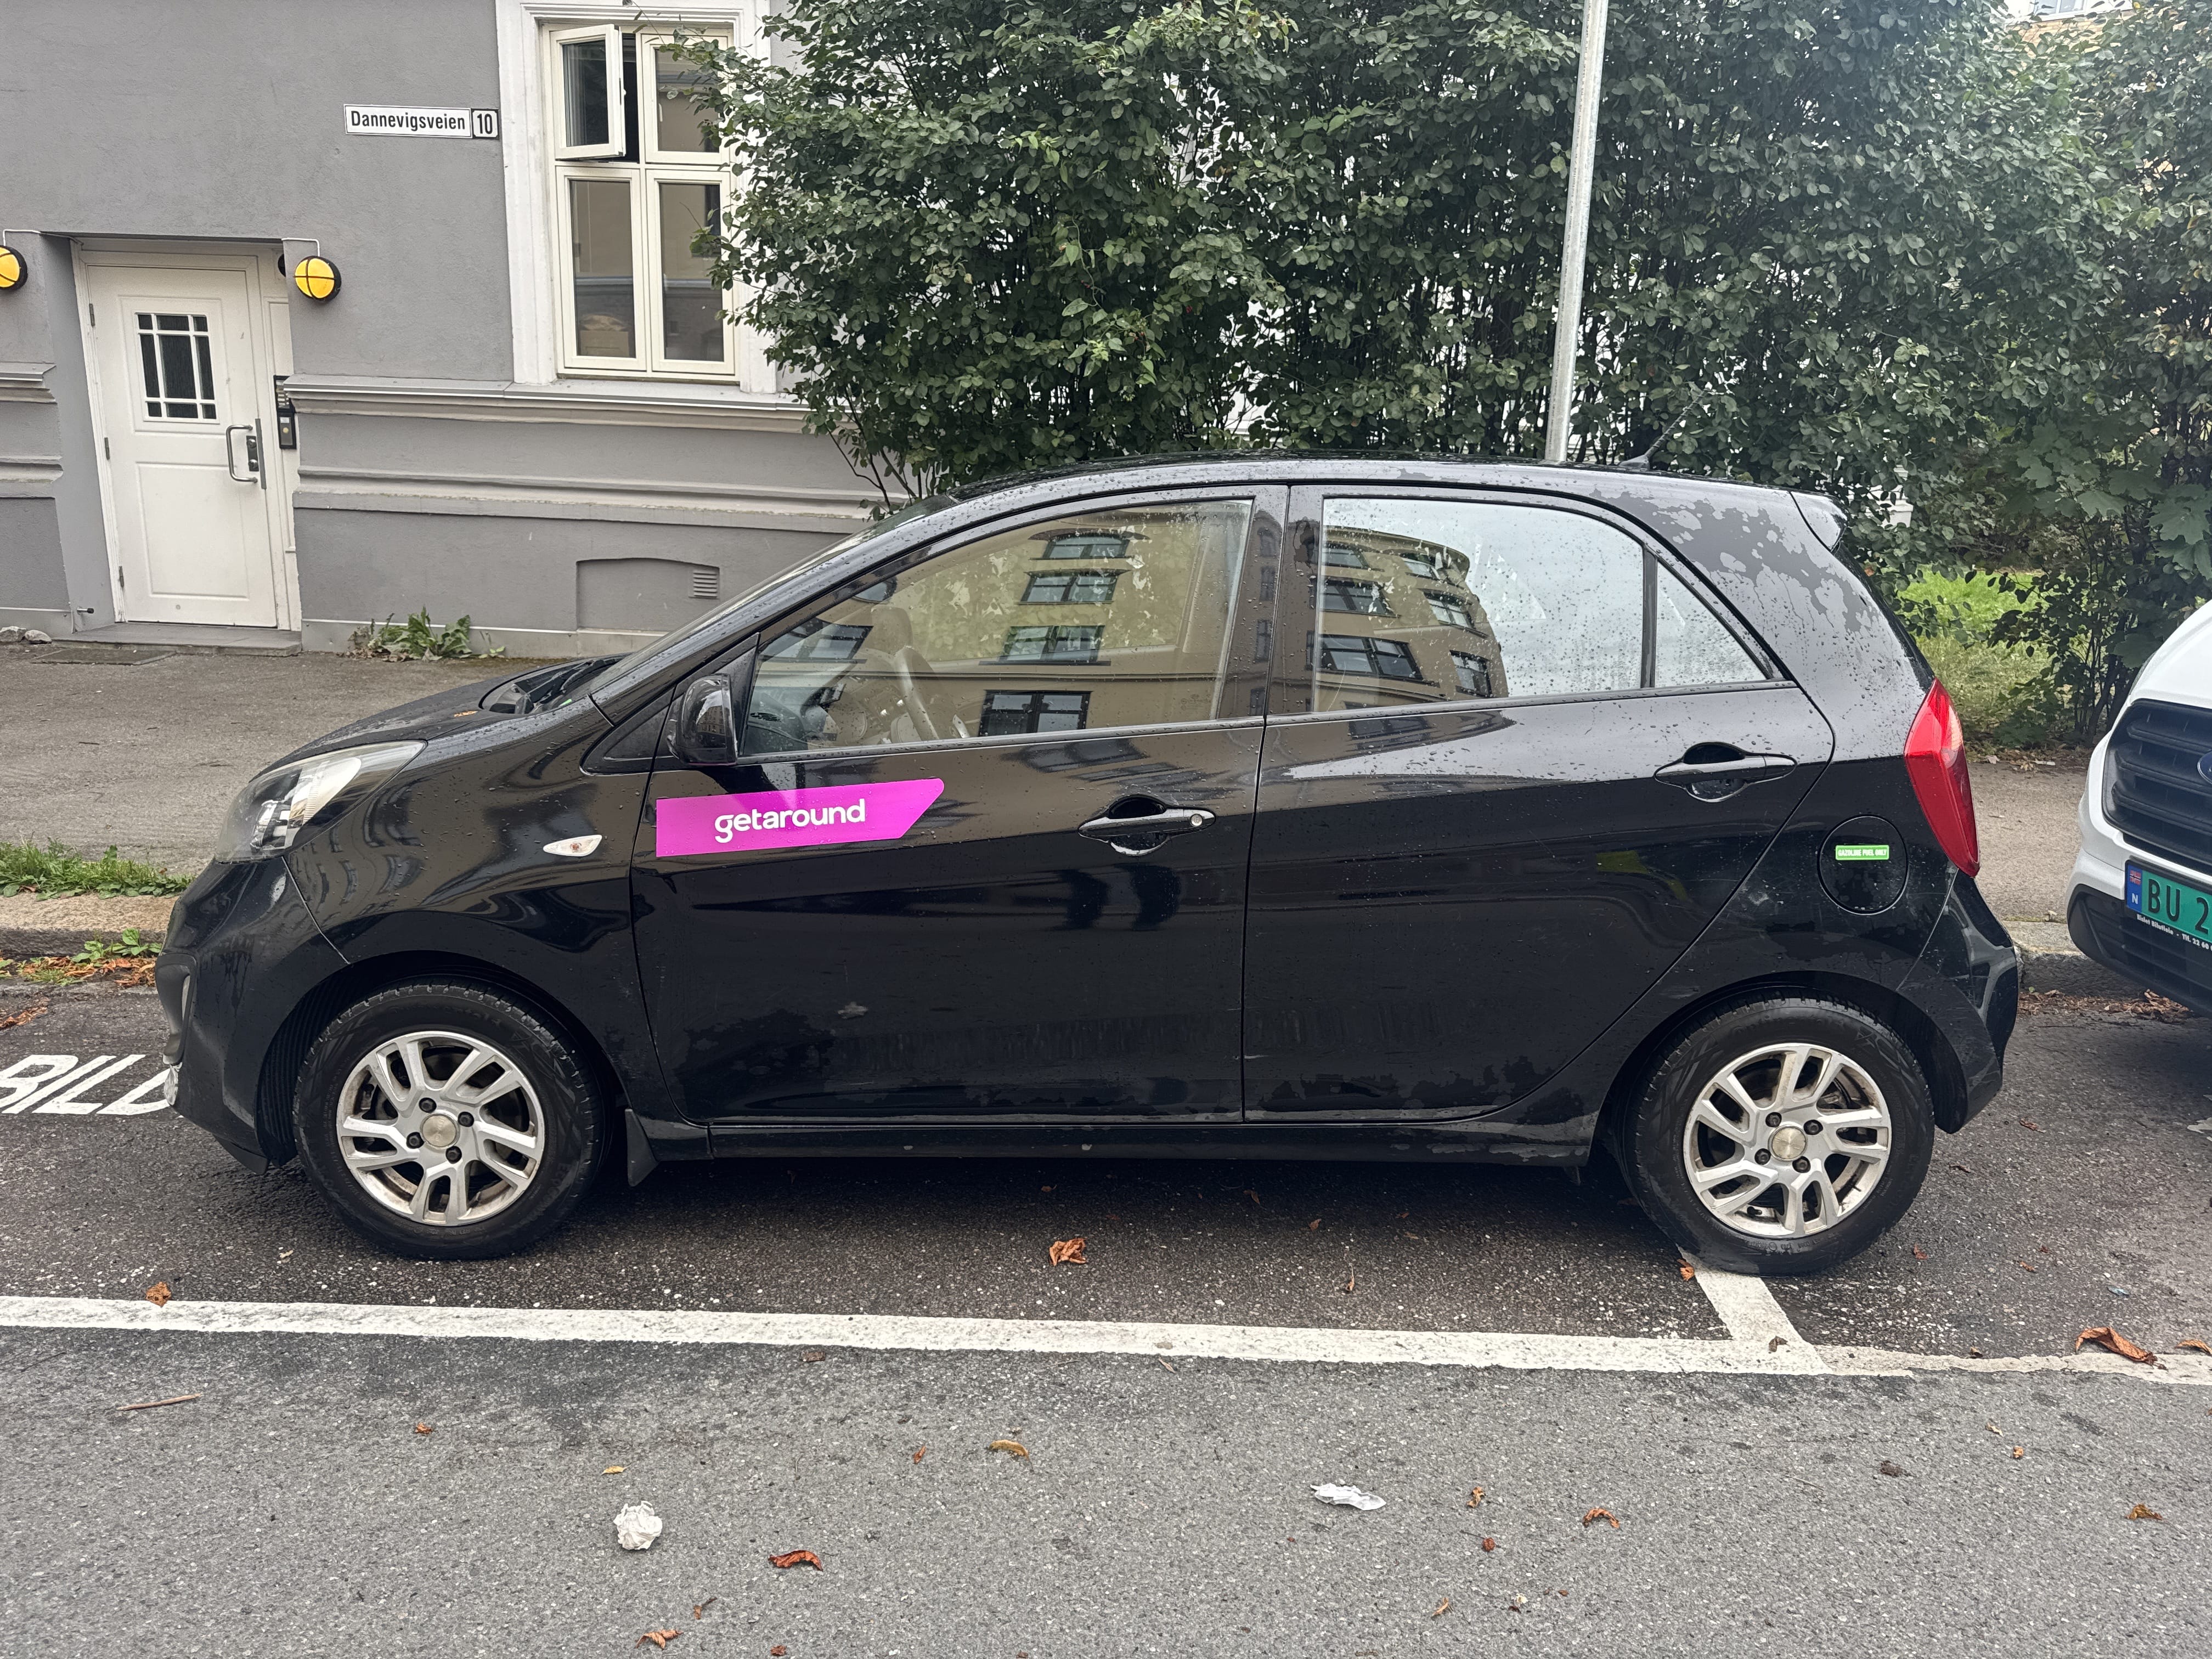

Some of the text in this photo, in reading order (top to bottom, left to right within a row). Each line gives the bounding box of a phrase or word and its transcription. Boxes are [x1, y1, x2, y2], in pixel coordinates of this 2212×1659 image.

[350, 110, 466, 132] Dannevigsveien
[477, 113, 493, 134] 10
[714, 798, 866, 843] getaround
[2132, 893, 2138, 905] N
[2148, 878, 2209, 934] BU 2
